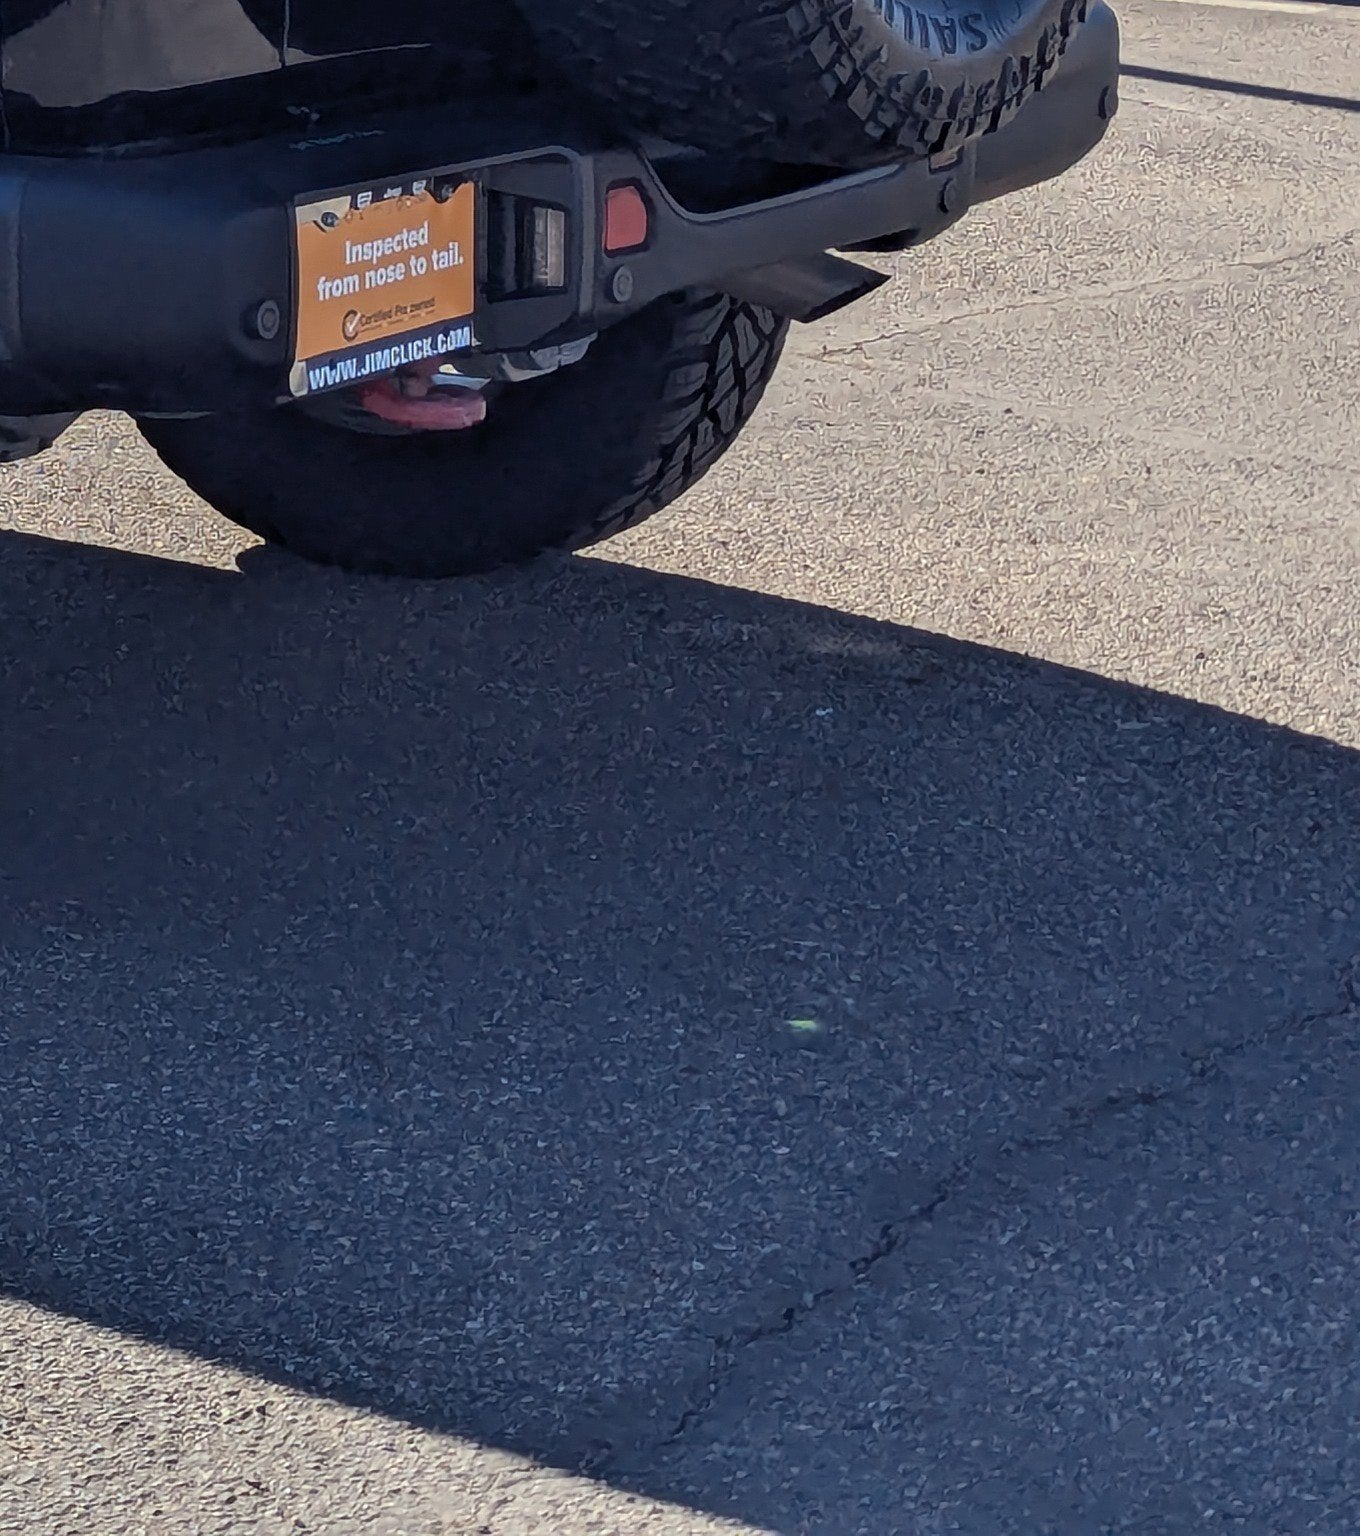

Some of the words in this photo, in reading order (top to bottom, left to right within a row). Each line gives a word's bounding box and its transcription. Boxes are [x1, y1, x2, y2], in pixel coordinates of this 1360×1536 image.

[317, 274, 360, 302] from
[365, 264, 405, 290] nose
[409, 253, 428, 276] to
[432, 241, 464, 271] tail.
[345, 221, 429, 265] Inspected
[309, 326, 471, 390] WWW.JIMCLICK.COM
